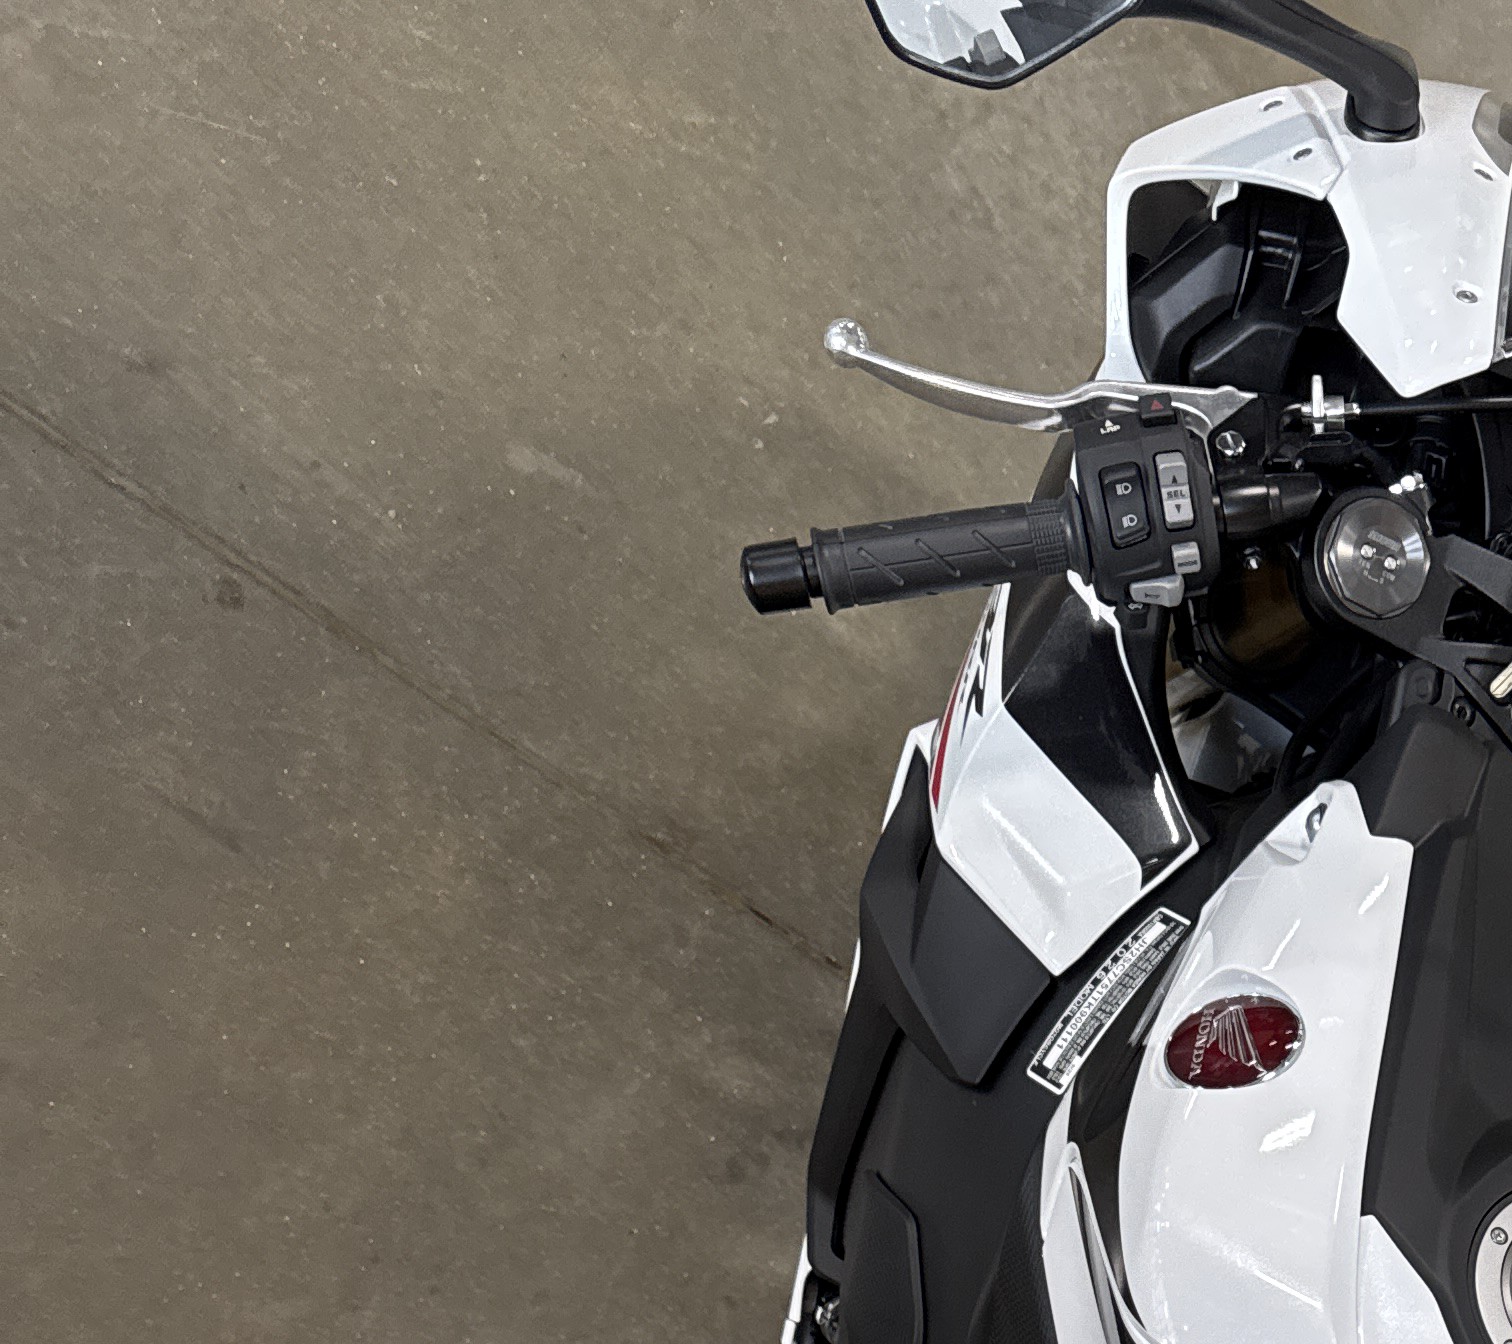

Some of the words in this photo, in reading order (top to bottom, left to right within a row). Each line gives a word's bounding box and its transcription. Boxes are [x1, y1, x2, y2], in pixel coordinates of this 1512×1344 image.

[1166, 489, 1187, 499] SEL
[1068, 984, 1095, 1019] MODEL
[1188, 1008, 1216, 1080] HONDA
